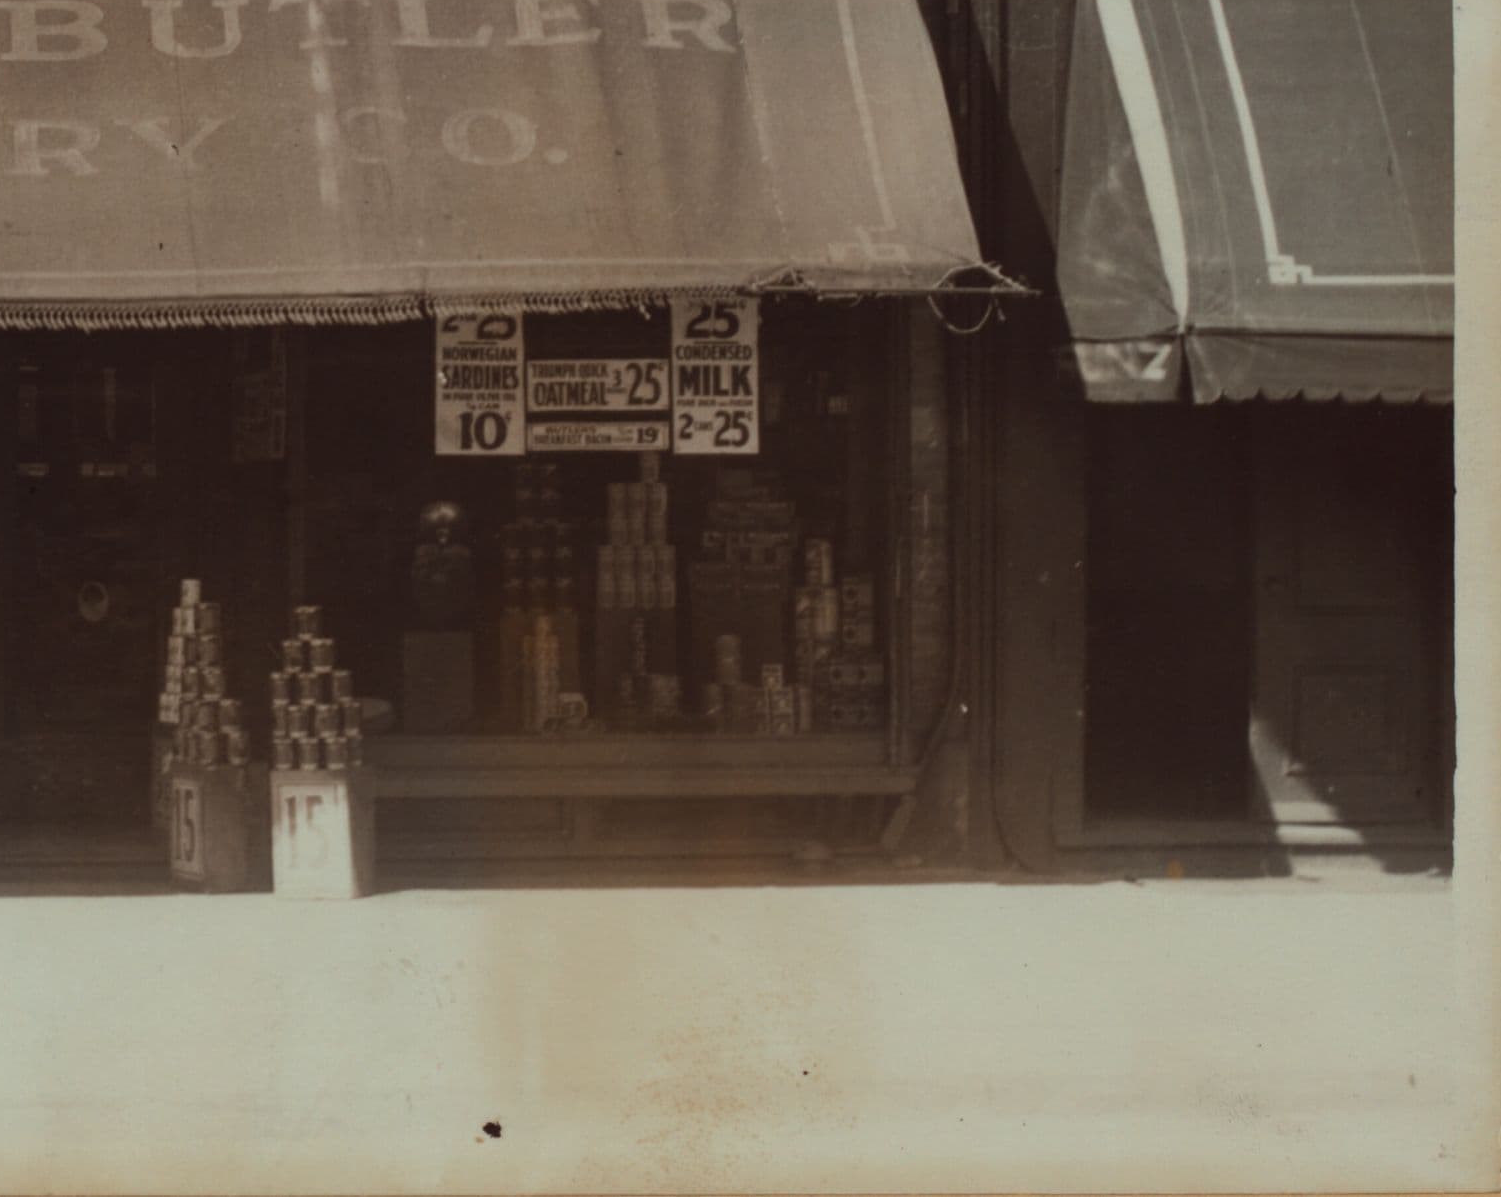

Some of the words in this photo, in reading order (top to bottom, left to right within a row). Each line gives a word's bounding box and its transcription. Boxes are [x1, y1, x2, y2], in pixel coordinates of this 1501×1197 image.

[338, 106, 569, 167] CO.
[442, 346, 518, 361] NORWEGIAN
[675, 344, 753, 361] CONDENSED
[441, 365, 520, 390] SARDINES
[678, 364, 753, 397] MILK
[534, 380, 609, 406] OATMEAL
[678, 413, 694, 440] 2
